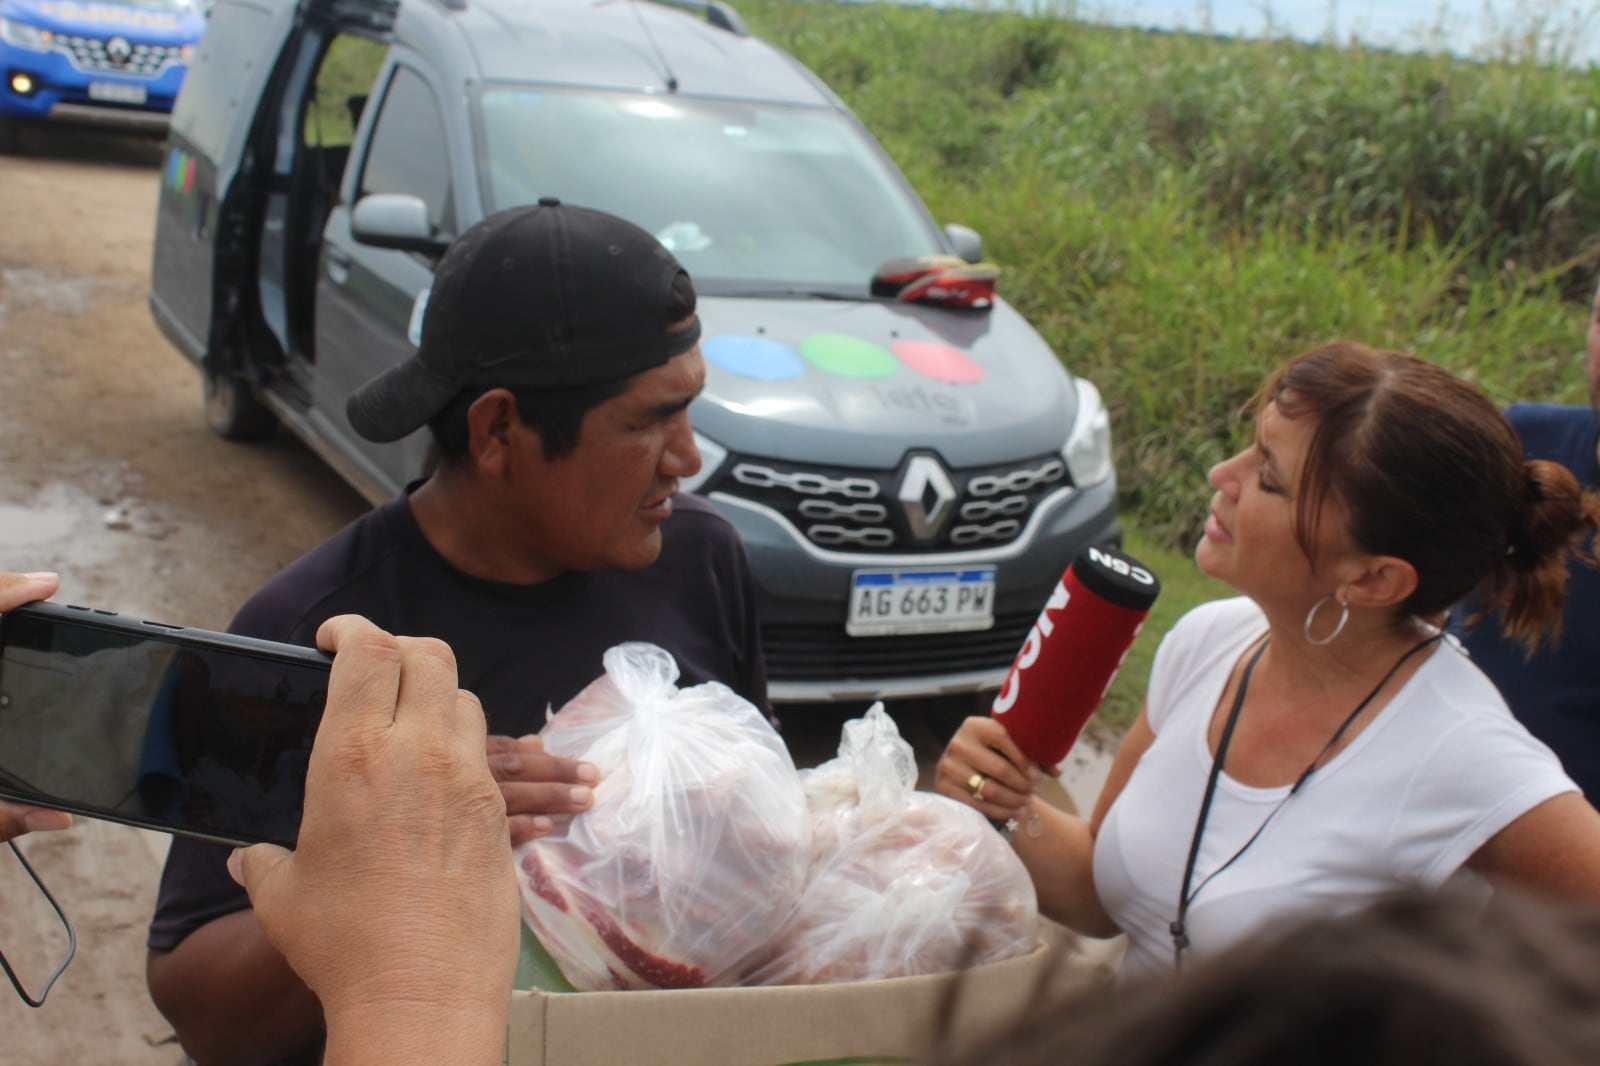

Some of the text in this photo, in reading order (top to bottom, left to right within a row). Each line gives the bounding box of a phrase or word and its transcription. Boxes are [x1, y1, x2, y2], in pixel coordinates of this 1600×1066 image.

[858, 586, 988, 617] AG 663 PW
